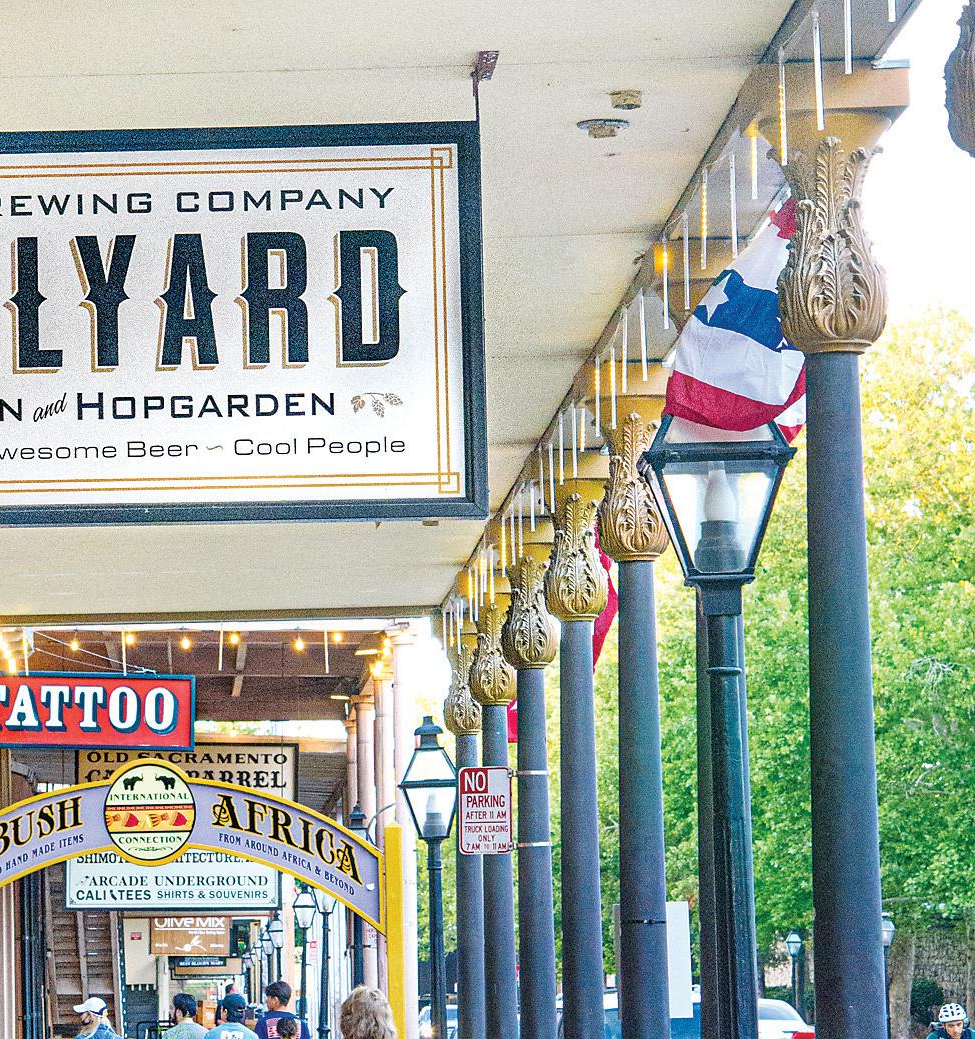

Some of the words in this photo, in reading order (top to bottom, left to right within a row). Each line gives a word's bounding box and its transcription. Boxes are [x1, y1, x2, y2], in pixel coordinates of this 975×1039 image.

[176, 187, 395, 212] COMPANY
[33, 392, 68, 423] and
[76, 392, 335, 421] HOPGARDEN
[126, 441, 198, 458] Beer
[234, 438, 297, 456] Cool
[307, 436, 406, 458] People
[86, 751, 129, 763] OLD
[137, 752, 287, 764] SACRAMENTO
[464, 771, 486, 792] NO
[109, 792, 190, 801] INTERNATIONAL
[466, 794, 506, 808] PARKING
[465, 811, 487, 820] AFTER
[489, 811, 495, 819] 11
[496, 810, 507, 819] AM
[464, 825, 483, 833] TRUCK
[484, 825, 509, 833] LOADING
[118, 835, 183, 844] CONNECTION
[211, 793, 364, 885] AFRICA
[477, 834, 496, 842] ONLY
[5, 853, 29, 871] HAND
[32, 842, 56, 859] MADE
[59, 833, 85, 848] ITEMS
[218, 832, 241, 846] FROM
[244, 839, 279, 857] AROUND
[282, 853, 312, 872] AFRICA
[314, 865, 322, 876] &
[324, 870, 355, 896] BEYOND
[88, 875, 148, 886] ARCADE
[154, 875, 268, 887] UNDERGROUND
[76, 889, 106, 901] CALI
[117, 889, 152, 901] TEES
[157, 890, 195, 899] SHIRTS
[197, 890, 206, 899] &
[209, 890, 268, 899] SOUVENIRS
